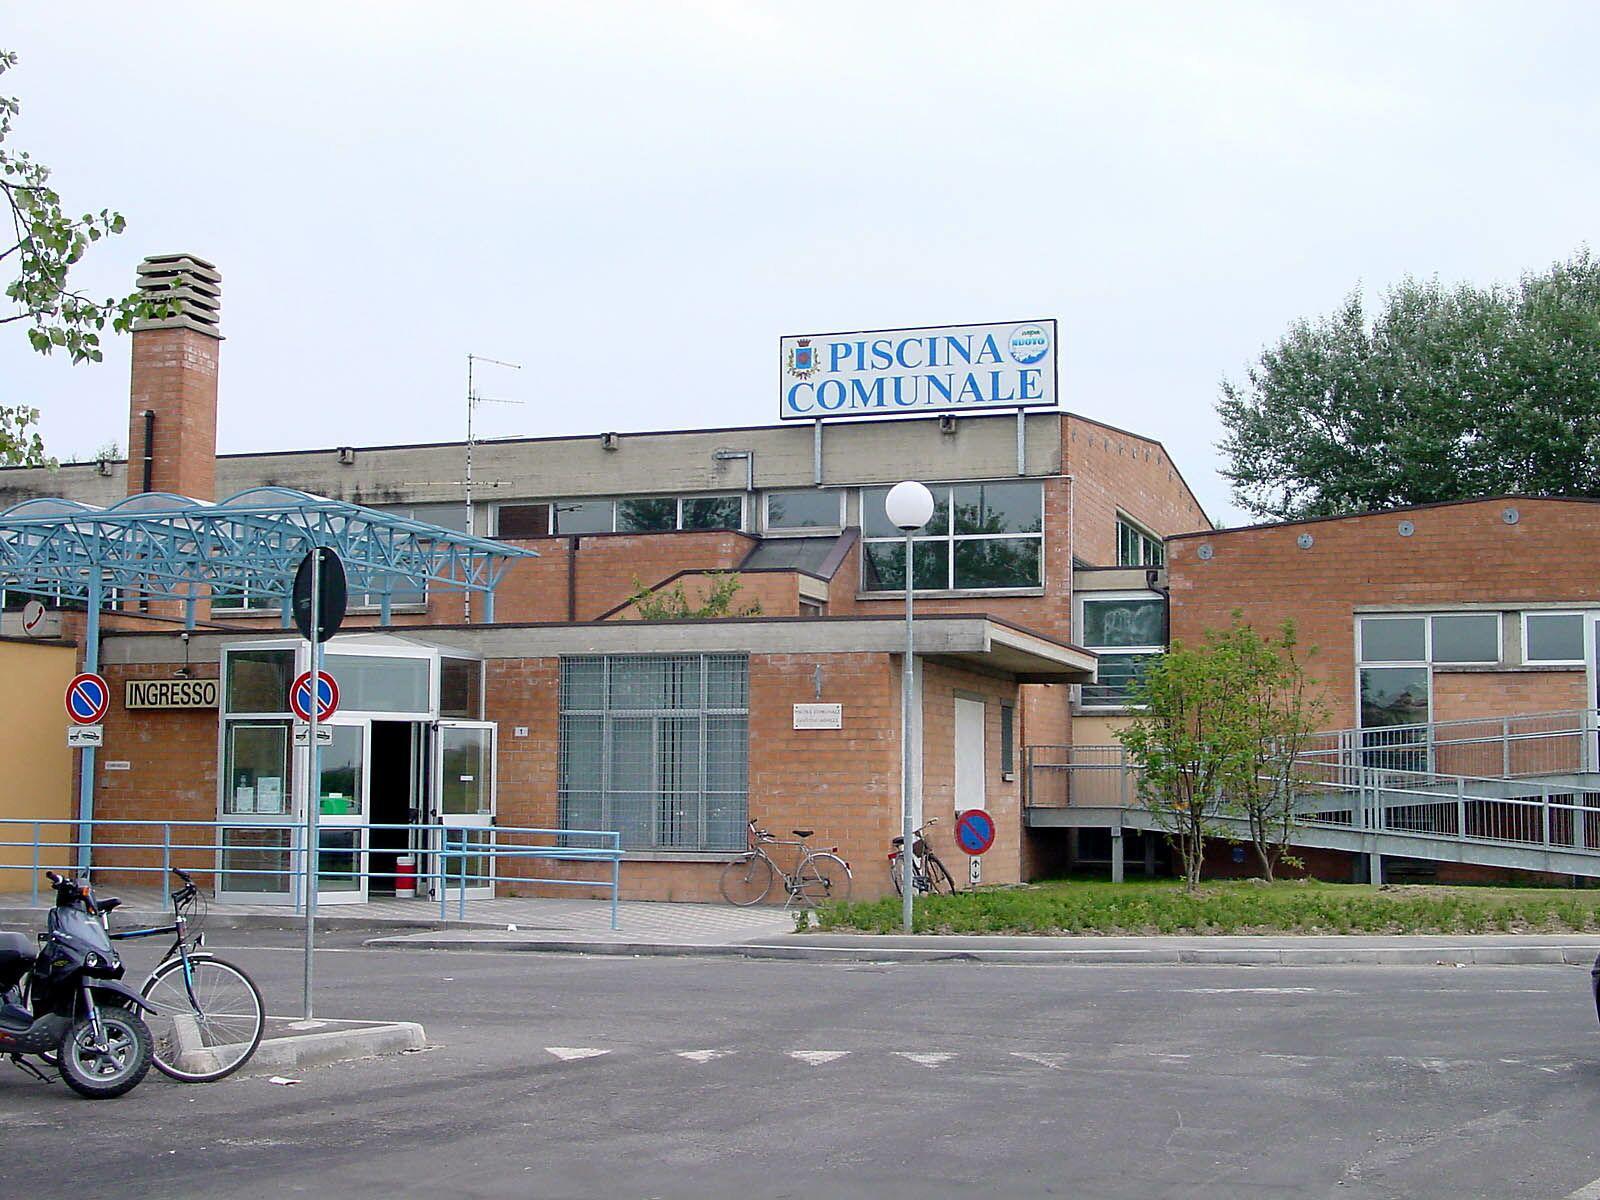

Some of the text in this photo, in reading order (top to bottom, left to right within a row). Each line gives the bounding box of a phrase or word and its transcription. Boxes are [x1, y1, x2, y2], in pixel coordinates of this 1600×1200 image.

[827, 333, 1005, 373] PISCINA
[787, 368, 1043, 413] COMUNALE
[129, 682, 216, 706] INGRESSO
